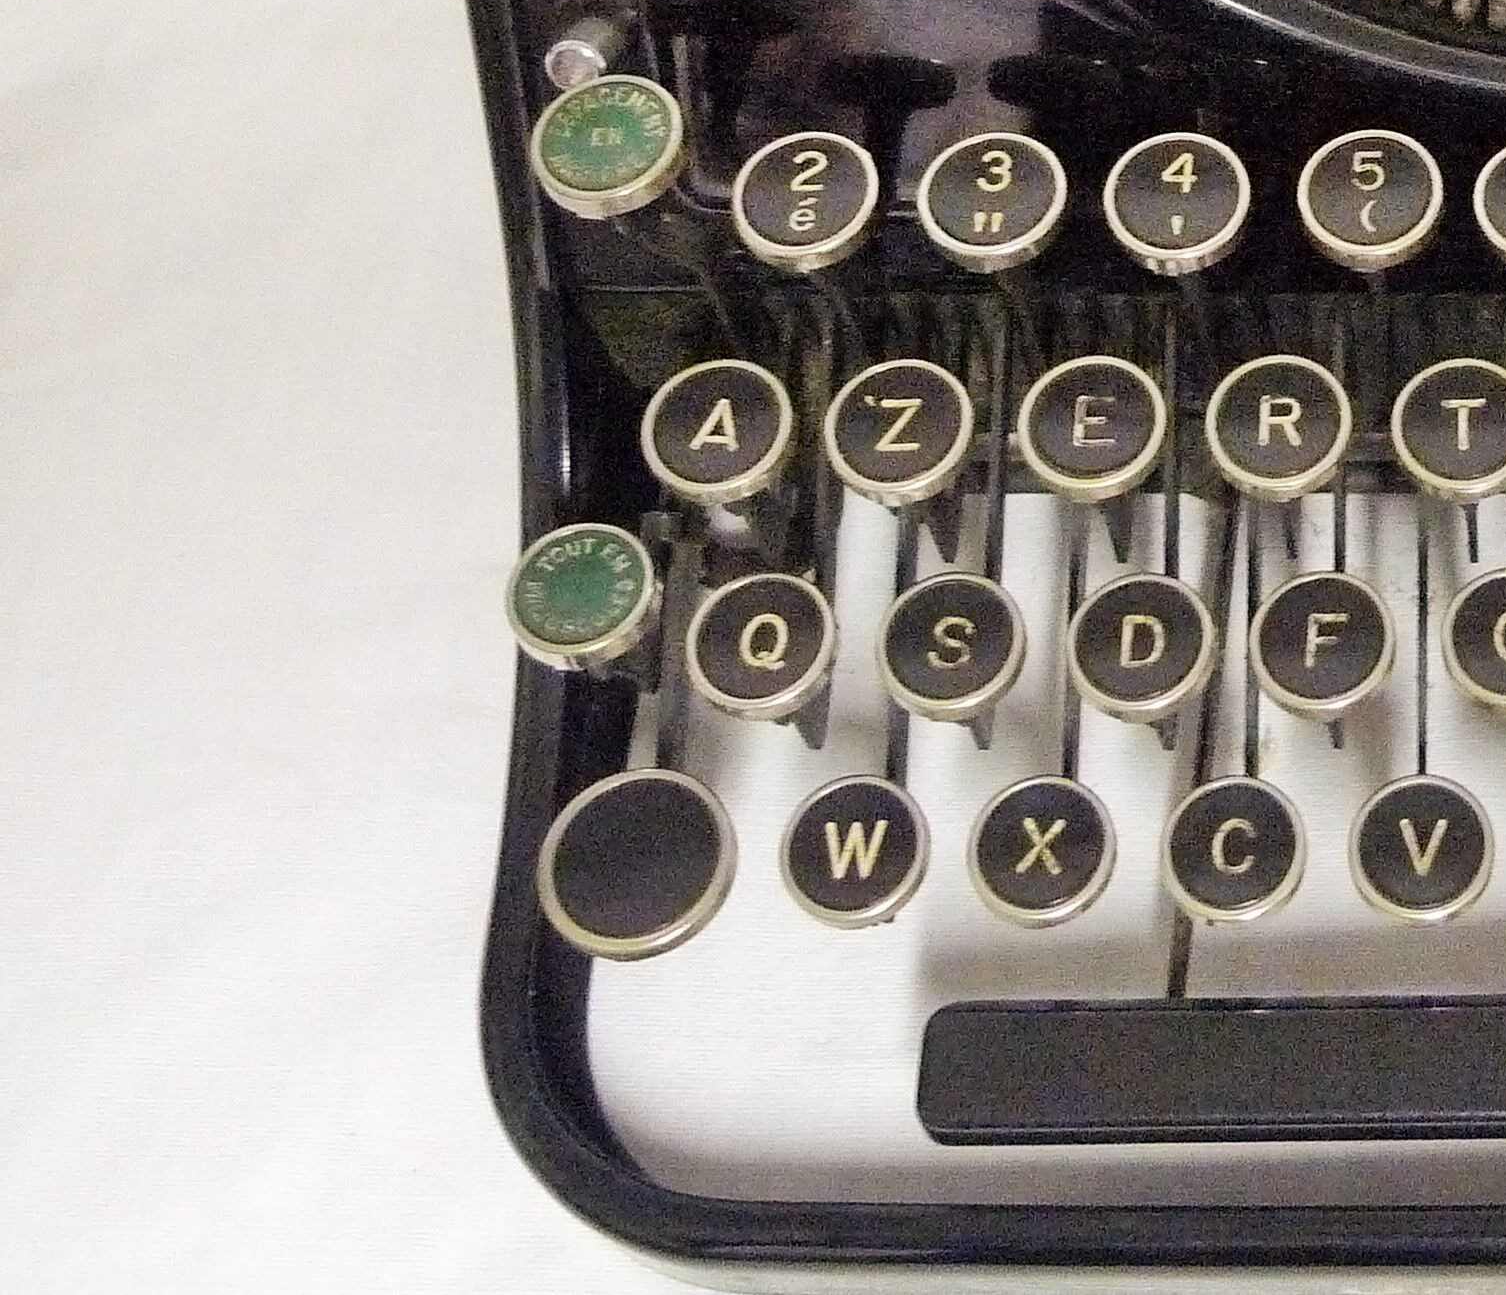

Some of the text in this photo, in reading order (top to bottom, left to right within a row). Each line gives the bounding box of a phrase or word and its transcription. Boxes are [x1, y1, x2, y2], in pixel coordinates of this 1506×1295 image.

[789, 150, 828, 193] 2
[976, 150, 1013, 193] 3
[1161, 152, 1198, 194] 4
[1351, 150, 1385, 191] 5
[688, 397, 738, 452] A
[873, 397, 923, 451] Z
[1072, 395, 1116, 448] E
[1257, 394, 1302, 447] R
[1441, 397, 1487, 451] T
[738, 612, 788, 671] Q
[927, 615, 975, 670] S
[1119, 614, 1165, 668] D
[1305, 612, 1348, 668] F
[825, 819, 889, 881] W
[1015, 817, 1067, 875] X
[1211, 818, 1256, 874] C
[1399, 818, 1448, 877] V
